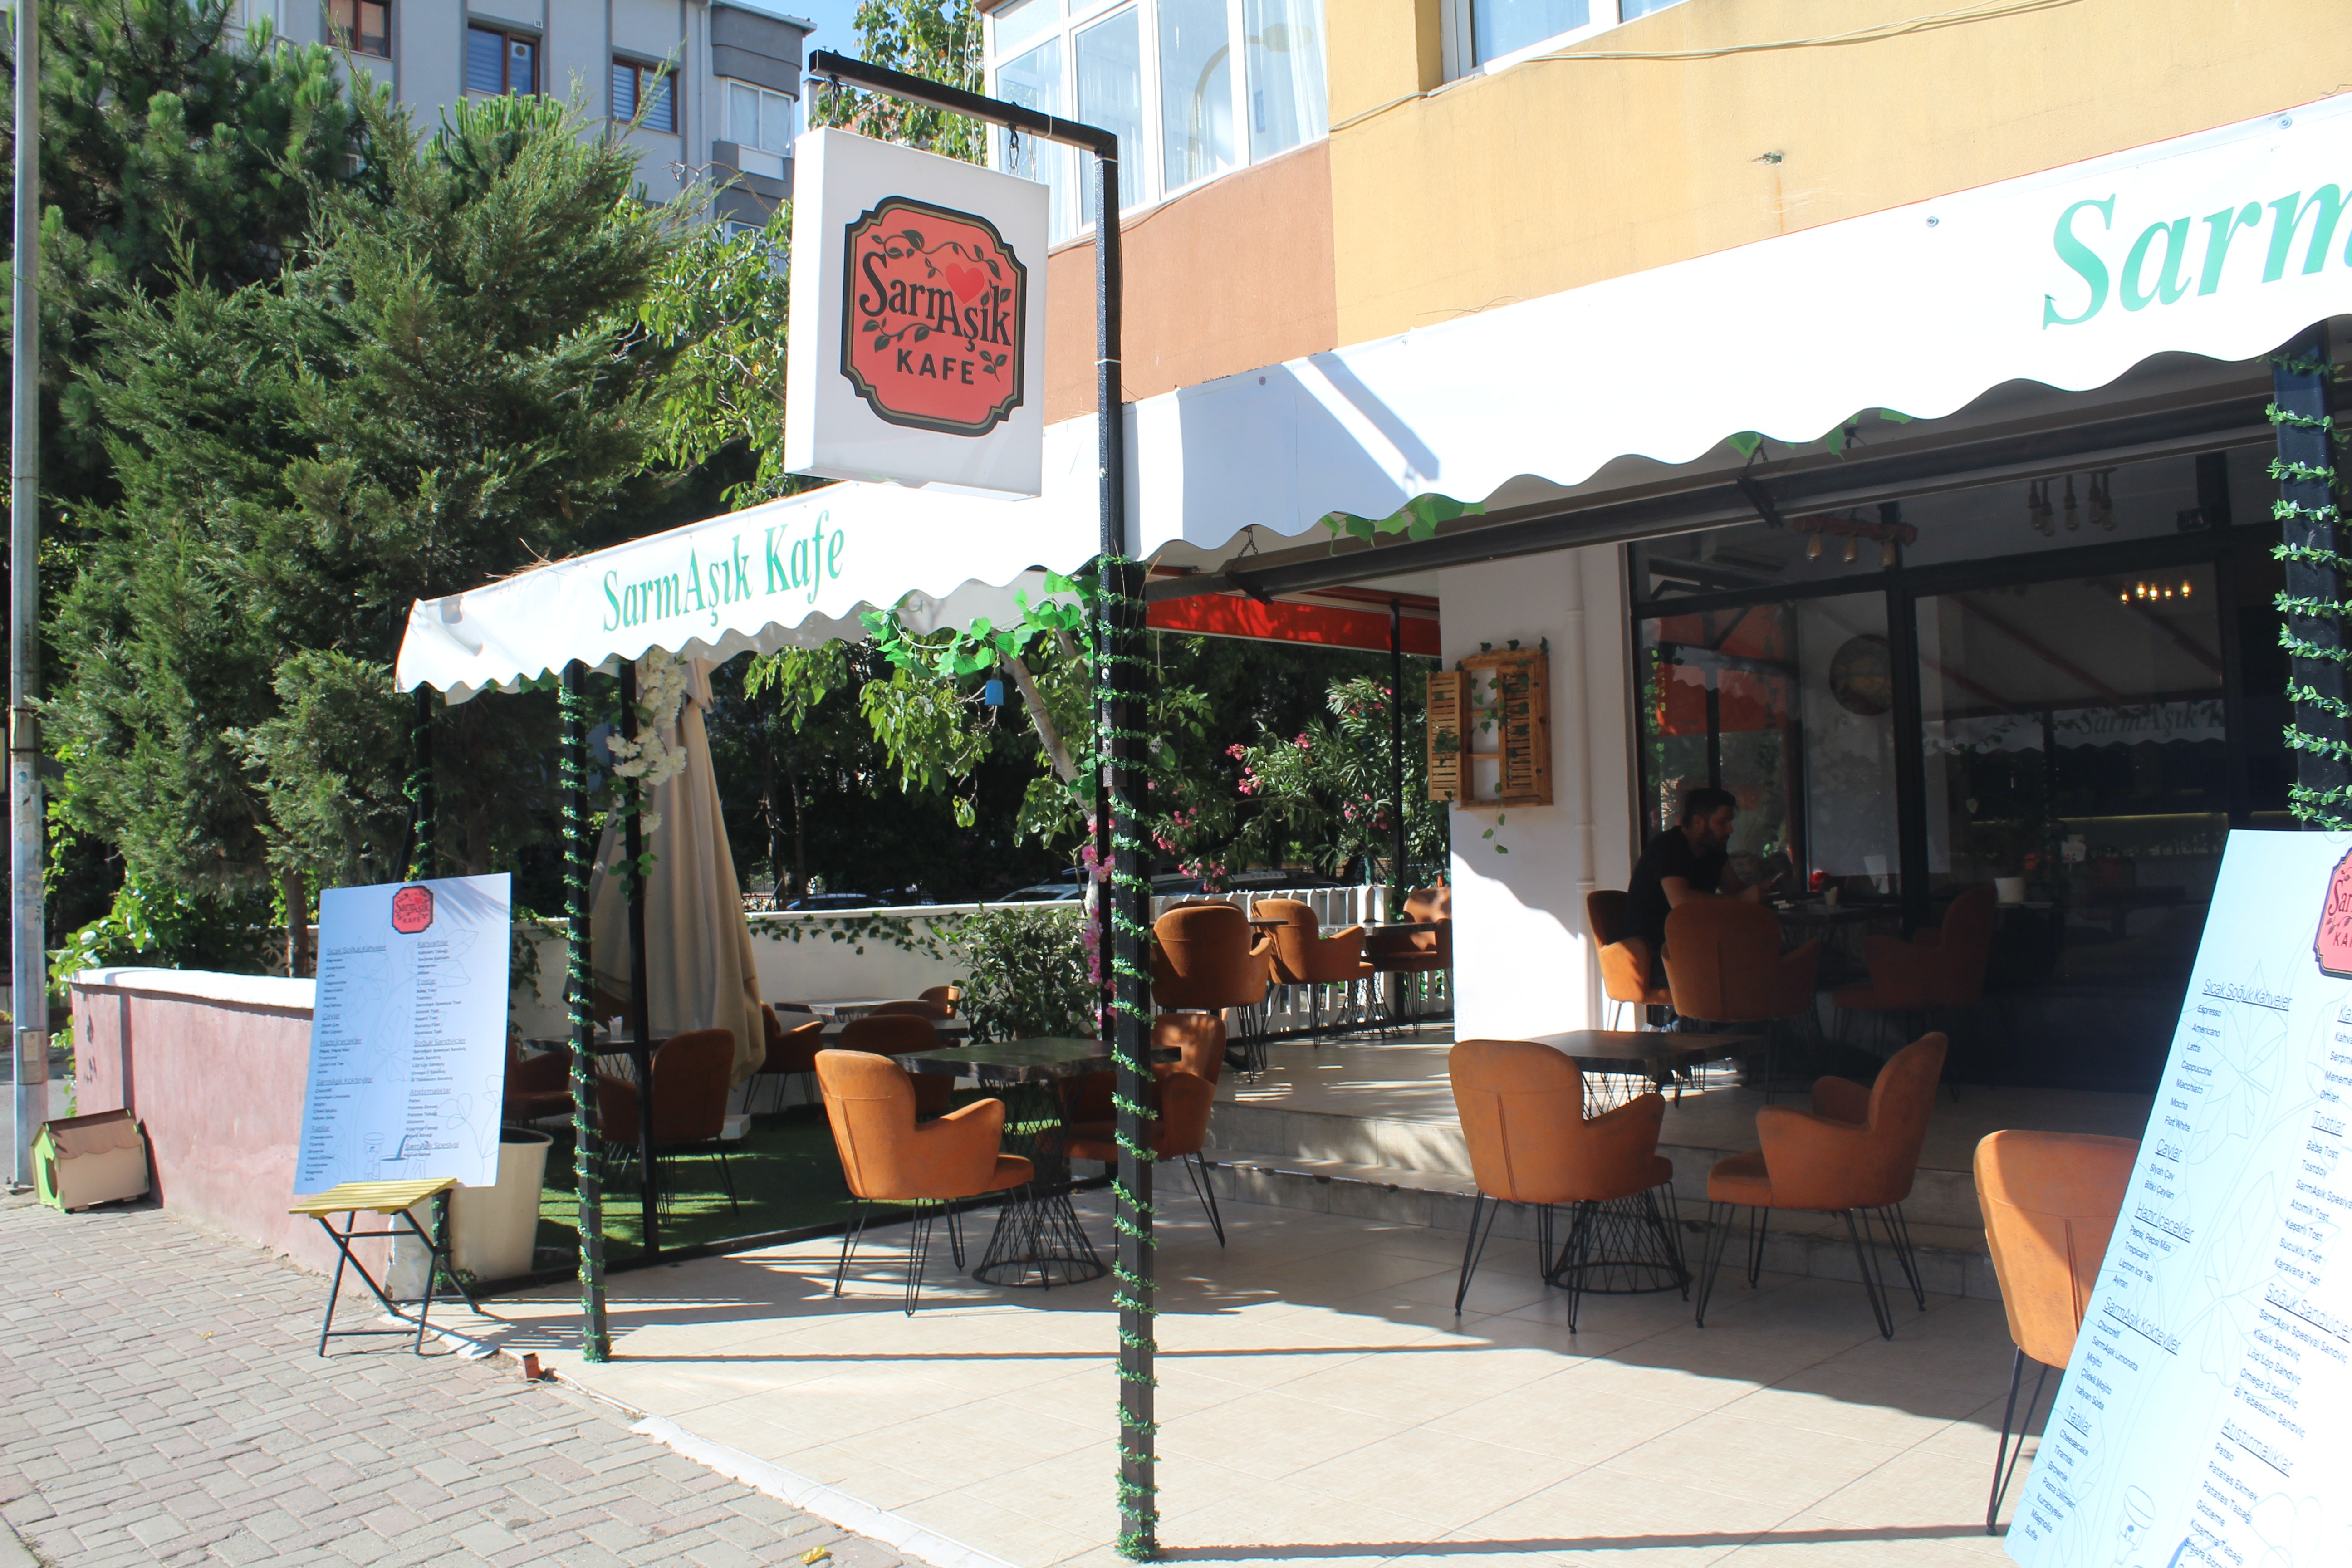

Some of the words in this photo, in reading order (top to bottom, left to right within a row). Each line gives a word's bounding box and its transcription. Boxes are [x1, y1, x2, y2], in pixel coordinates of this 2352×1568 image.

[897, 348, 975, 385] KAFE
[603, 534, 754, 633] SarmAşık
[765, 509, 844, 604] Kafe
[2226, 983, 2253, 1002] Soğuk
[2254, 989, 2292, 1009] Kahveler
[2197, 1004, 2221, 1017] Espresso
[2191, 1023, 2220, 1037] Americano
[2186, 1042, 2201, 1053] Latte
[2181, 1060, 2212, 1076] Cappuccino
[2176, 1078, 2204, 1094] Macchiato
[2320, 1090, 2339, 1103] Omlet
[2170, 1097, 2189, 1111] Mocha
[2164, 1116, 2176, 1127] Flat
[2175, 1117, 2191, 1132] White
[2313, 1110, 2346, 1134] Tostlar
[2156, 1138, 2183, 1161] Çaylar
[2306, 1140, 2322, 1154] Baba
[2324, 1146, 2339, 1160] Tost
[2149, 1163, 2164, 1176] Siyah
[2164, 1169, 2176, 1182] Çay
[2301, 1159, 2328, 1180] Tostdoy
[2135, 1201, 2157, 1224] Hazır
[2156, 1208, 2195, 1240] İçecekler
[2290, 1198, 2314, 1216] Atomik
[2314, 1207, 2330, 1222] Tost
[2145, 1233, 2160, 1247] Pepsi
[2160, 1239, 2172, 1253] Max
[2308, 1227, 2323, 1242] Tost
[2124, 1241, 2150, 1261] Tropicana
[2279, 1237, 2306, 1257] Sucuklu
[2307, 1249, 2322, 1264] Tost
[2118, 1257, 2135, 1274] Lipton
[2134, 1266, 2144, 1277] Ice
[2143, 1271, 2153, 1283] Tea
[2274, 1256, 2304, 1279] Karavana
[2306, 1271, 2321, 1286] Tost
[2112, 1274, 2128, 1289] Ayran
[2265, 1283, 2298, 1312] Soğuk
[2253, 1328, 2274, 1346] Klasik
[2274, 1339, 2301, 1363] Sandviç
[2291, 1325, 2320, 1348] Spesiyal
[2320, 1341, 2348, 1366] Sandviç
[2086, 1351, 2102, 1368] Mojito
[2115, 1350, 2138, 1372] Limonata
[2095, 1377, 2112, 1395] Mojito
[2274, 1362, 2302, 1388] Sandviç
[2240, 1367, 2264, 1389] Omega
[2264, 1382, 2271, 1392] 3
[2270, 1385, 2298, 1411] Sandviç
[2091, 1396, 2105, 1411] Soda
[2234, 1387, 2242, 1398] Bi
[2243, 1391, 2277, 1420] Tebessüm
[2277, 1414, 2305, 1441] Sandviç
[2059, 1429, 2089, 1457] Cheesecake
[2214, 1442, 2234, 1462] Patso
[2053, 1444, 2075, 1466] Tiramisu
[2042, 1476, 2056, 1494] Pasta
[2208, 1460, 2234, 1486] Patates
[2234, 1479, 2259, 1503] Ekmek
[2202, 1480, 2228, 1506] Patates
[2030, 1508, 2053, 1534] Magnolia
[2196, 1499, 2225, 1527] Gözleme
